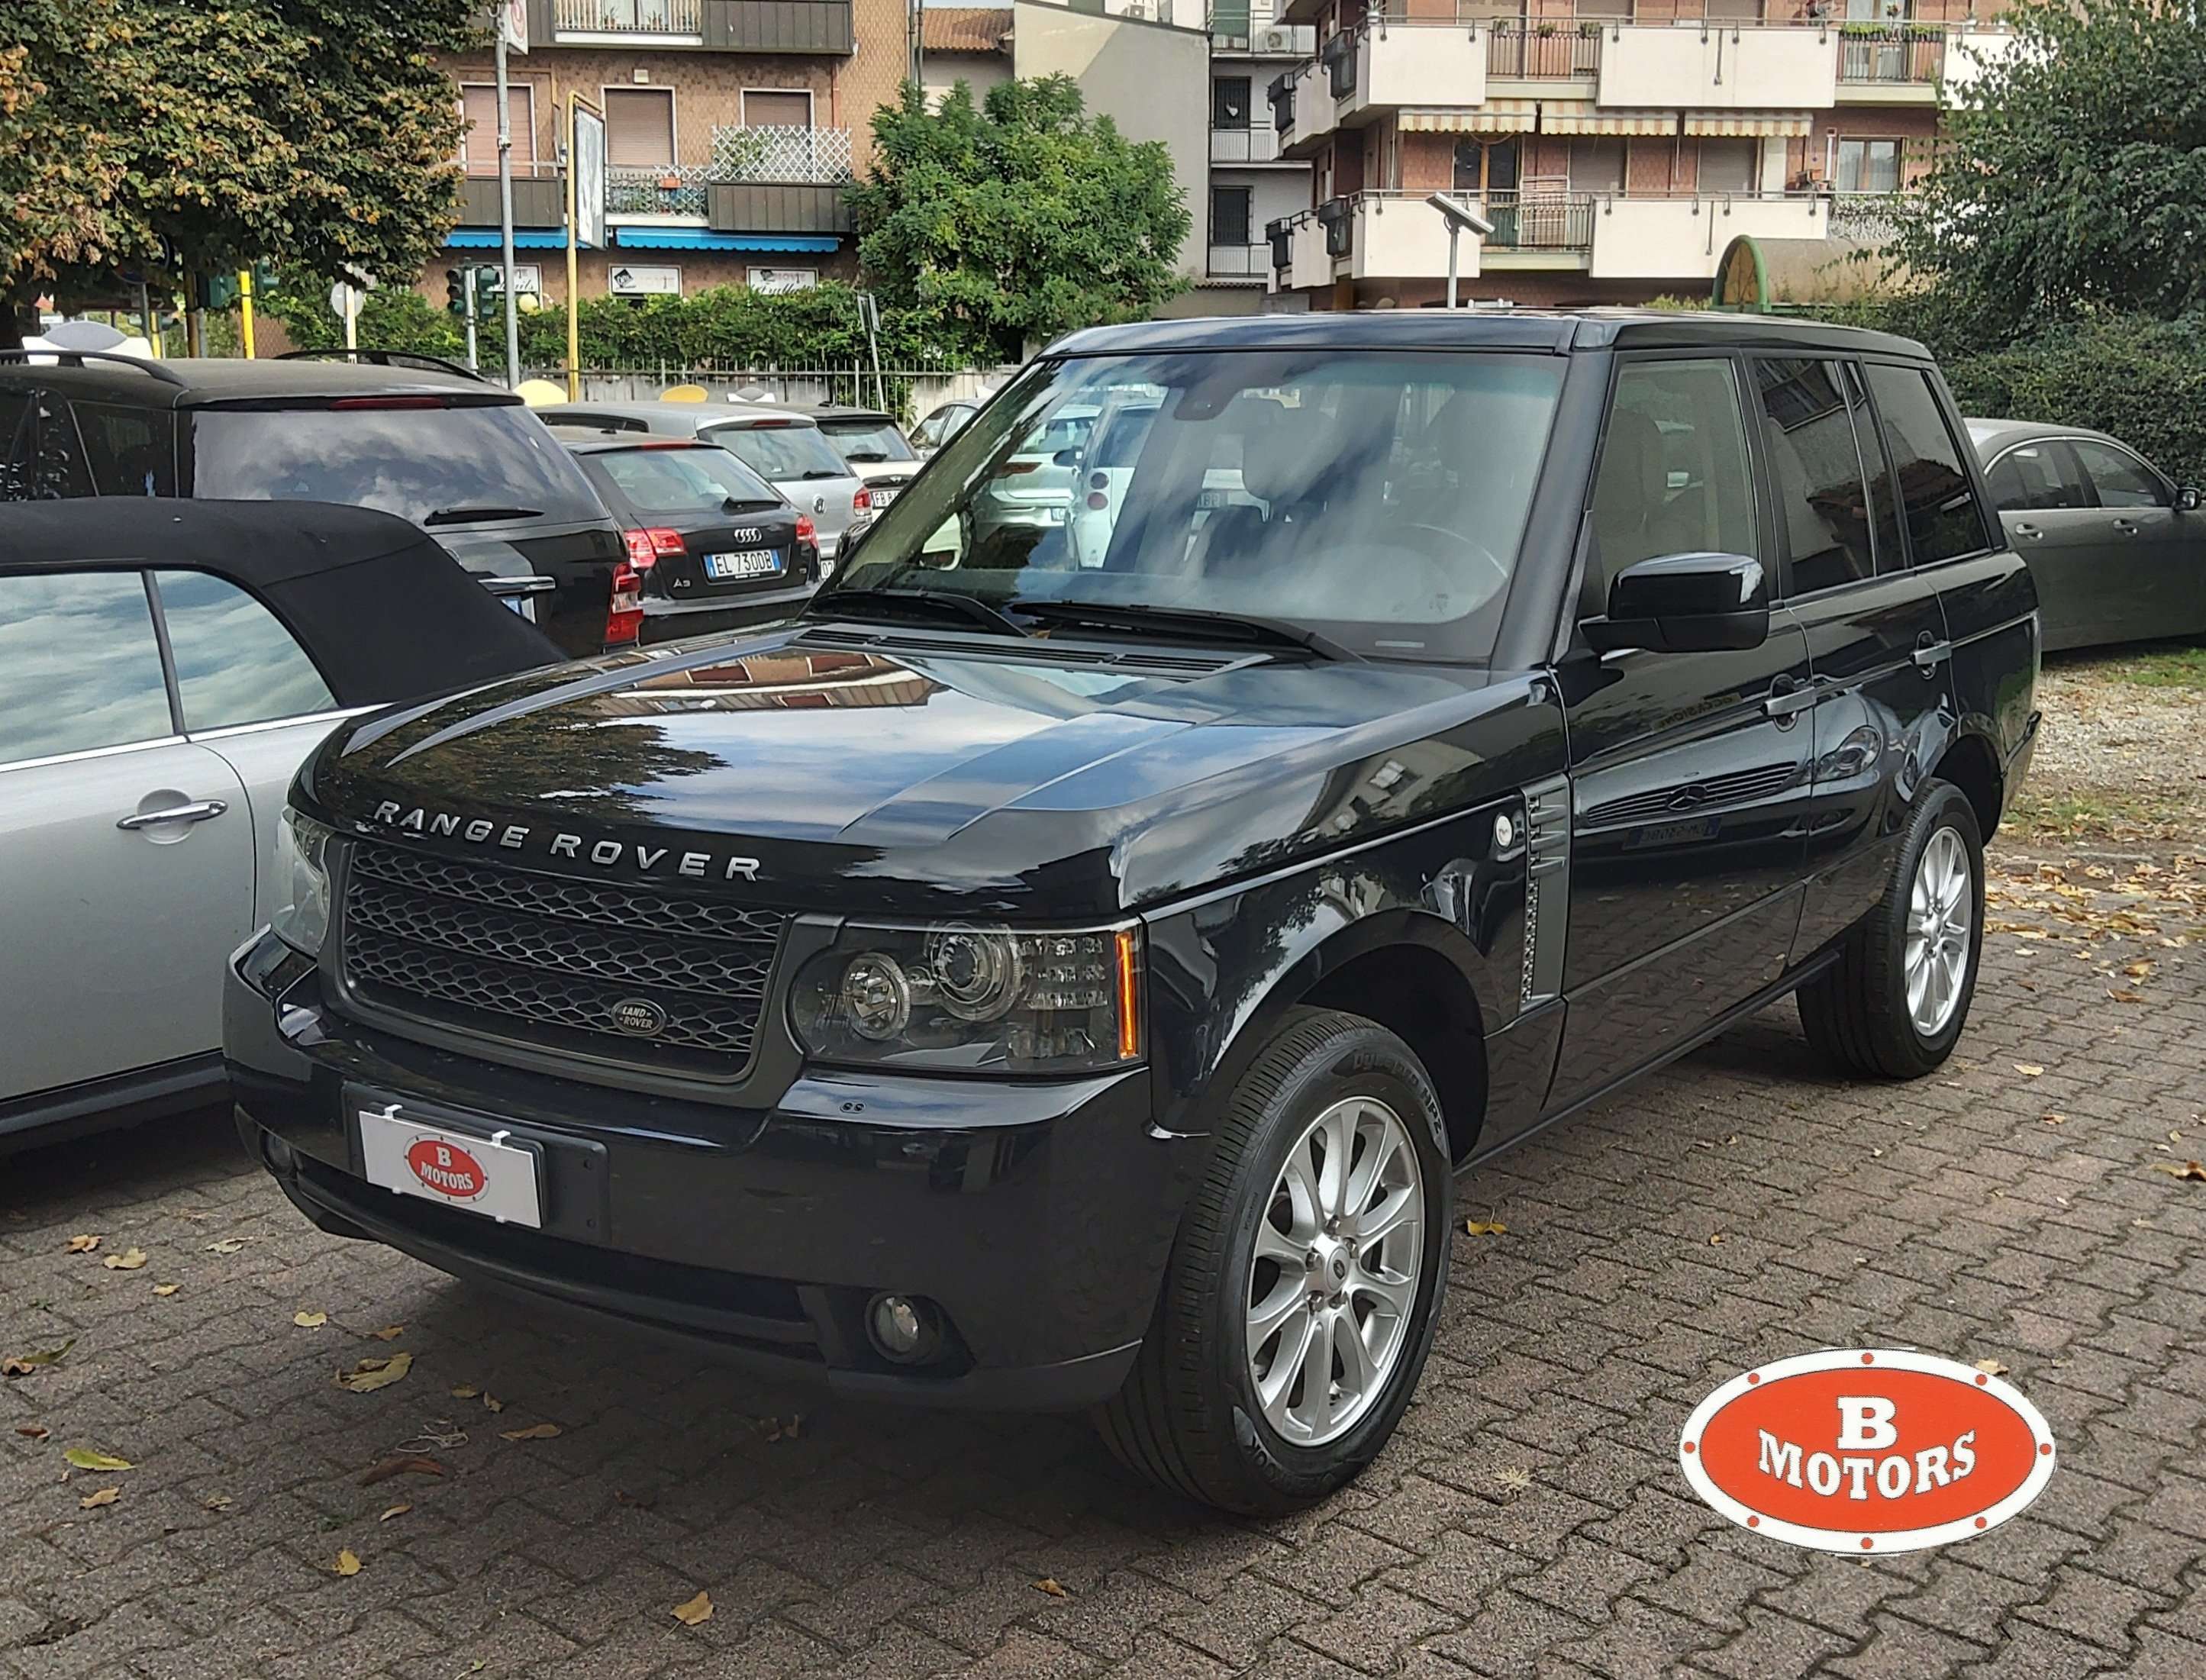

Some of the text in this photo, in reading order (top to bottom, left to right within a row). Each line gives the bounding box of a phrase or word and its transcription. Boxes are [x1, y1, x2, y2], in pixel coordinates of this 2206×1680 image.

[715, 551, 772, 574] EL 730DB
[672, 577, 691, 588] A3
[373, 800, 761, 882] RANGE ROVER
[622, 1006, 647, 1017] LAND
[623, 1016, 654, 1029] ROVER
[436, 1146, 453, 1167] B
[421, 1160, 475, 1191] MOTORS
